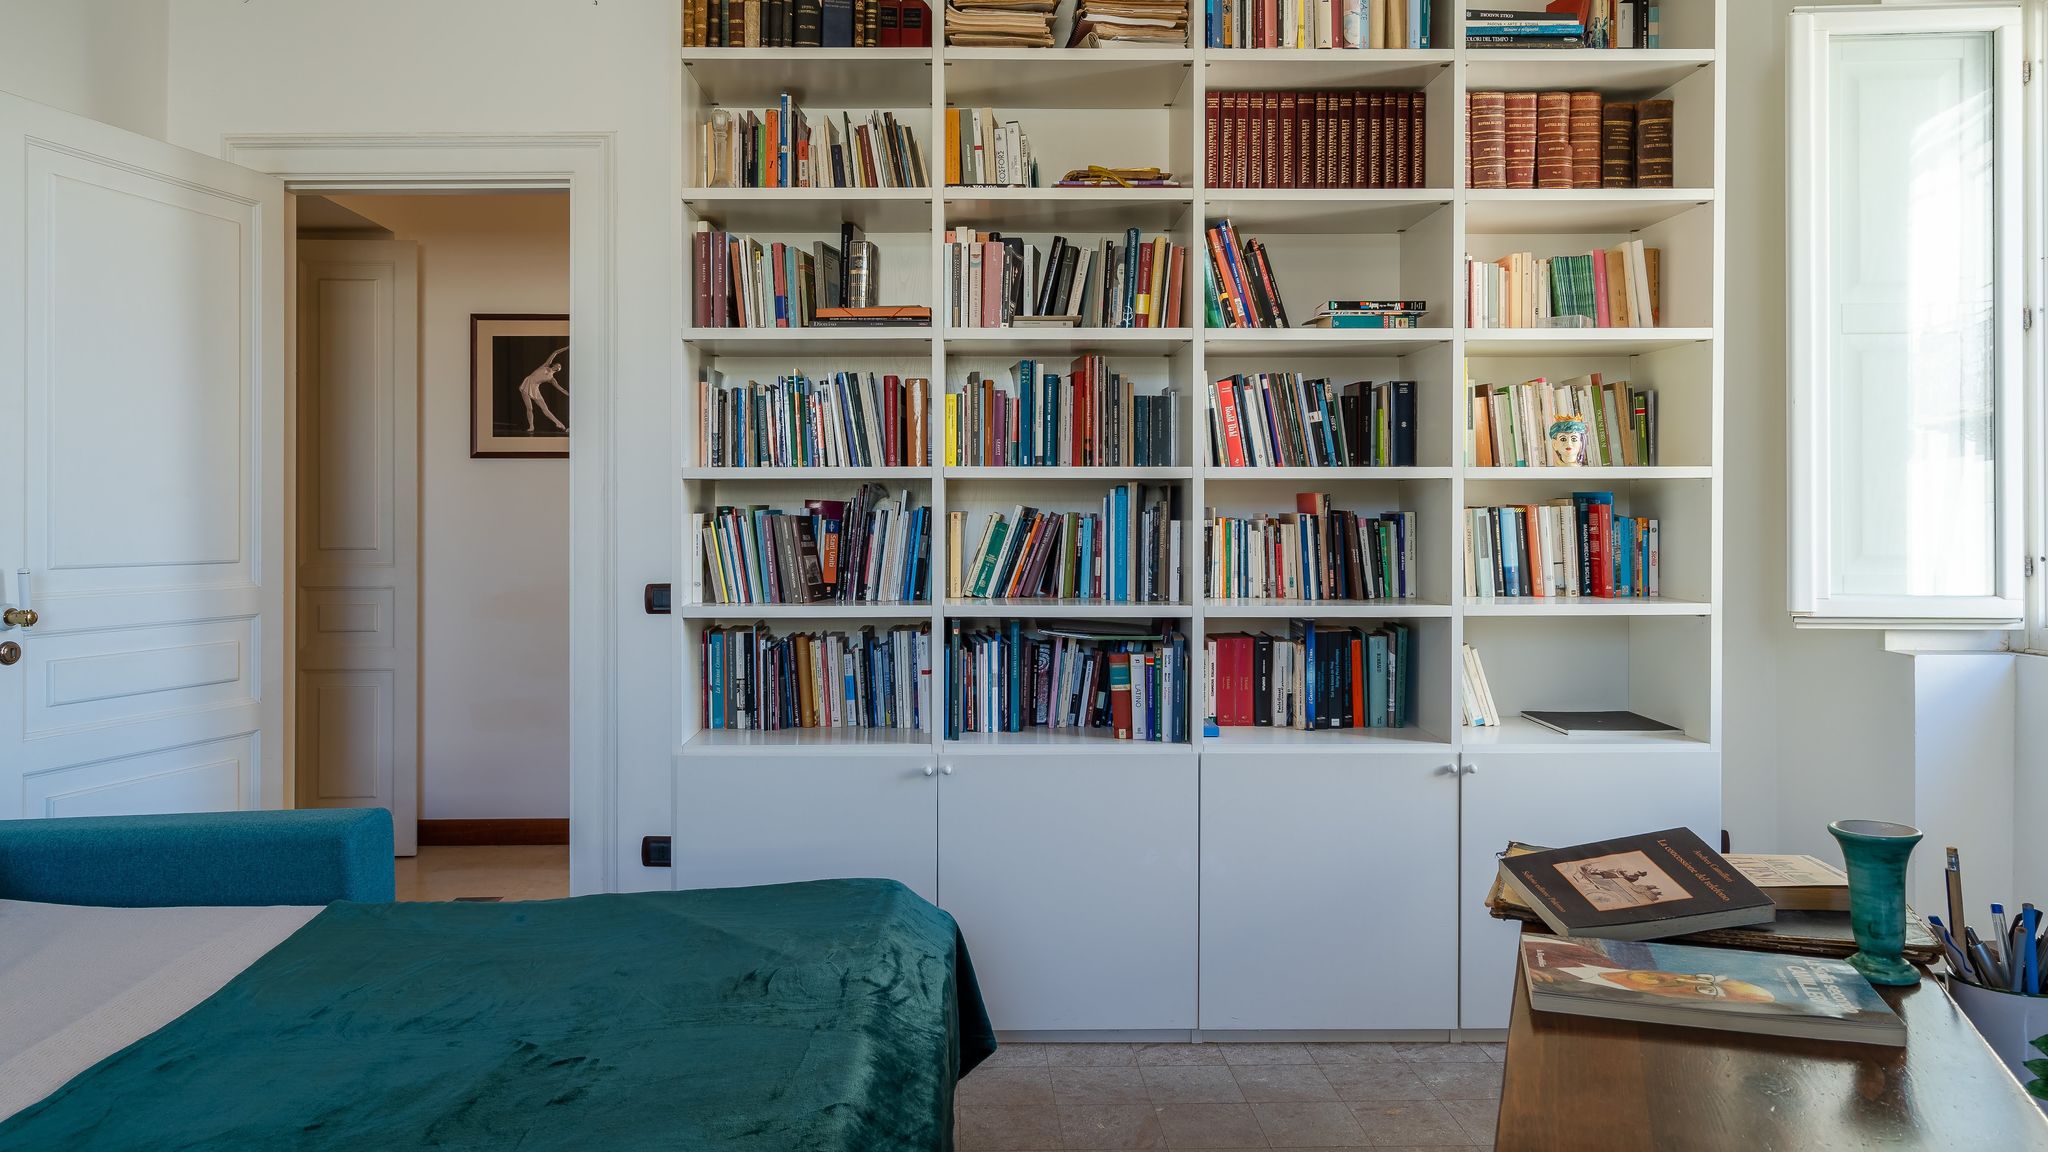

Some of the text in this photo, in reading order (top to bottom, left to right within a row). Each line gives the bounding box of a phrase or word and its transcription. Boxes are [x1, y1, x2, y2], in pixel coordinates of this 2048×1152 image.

[1225, 405, 1238, 437] Roald Dahl
[1658, 839, 1668, 848] La
[1664, 846, 1698, 874] concessione
[1704, 880, 1730, 902] telefono
[1693, 849, 1712, 865] Andrea
[1710, 864, 1734, 882] Camilleri
[1547, 896, 1567, 912] Palermo
